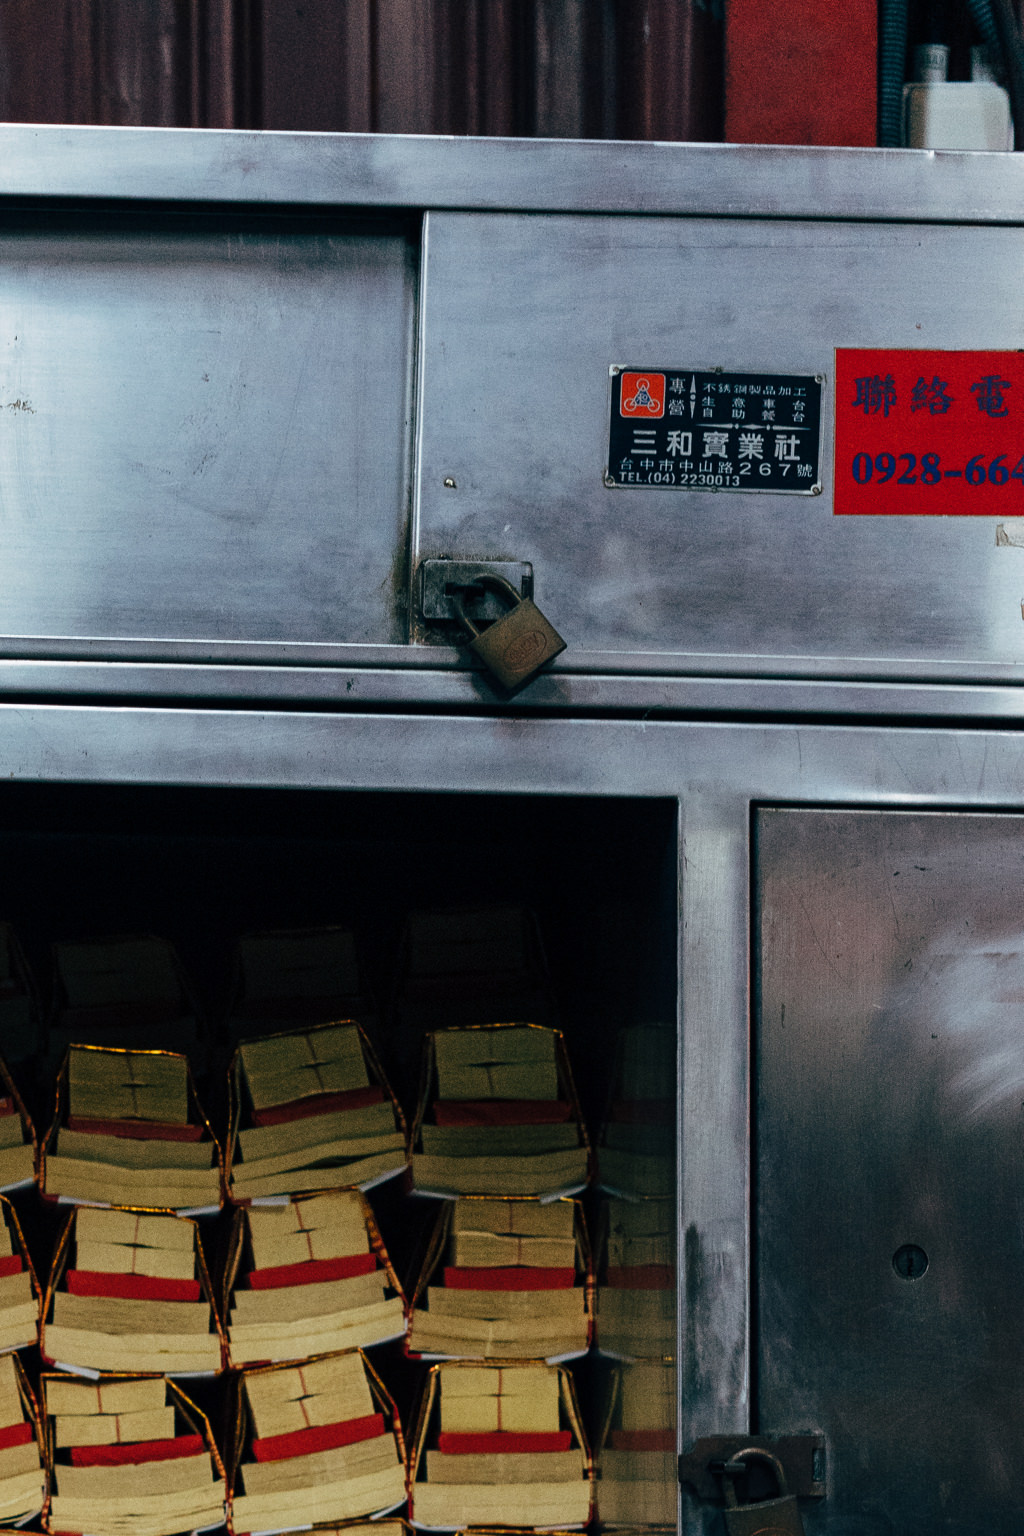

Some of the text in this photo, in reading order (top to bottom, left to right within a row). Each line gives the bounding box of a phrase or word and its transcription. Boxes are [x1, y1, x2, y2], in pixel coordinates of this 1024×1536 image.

[851, 373, 1012, 418] 聯絡電
[630, 429, 801, 462] 三和實業社
